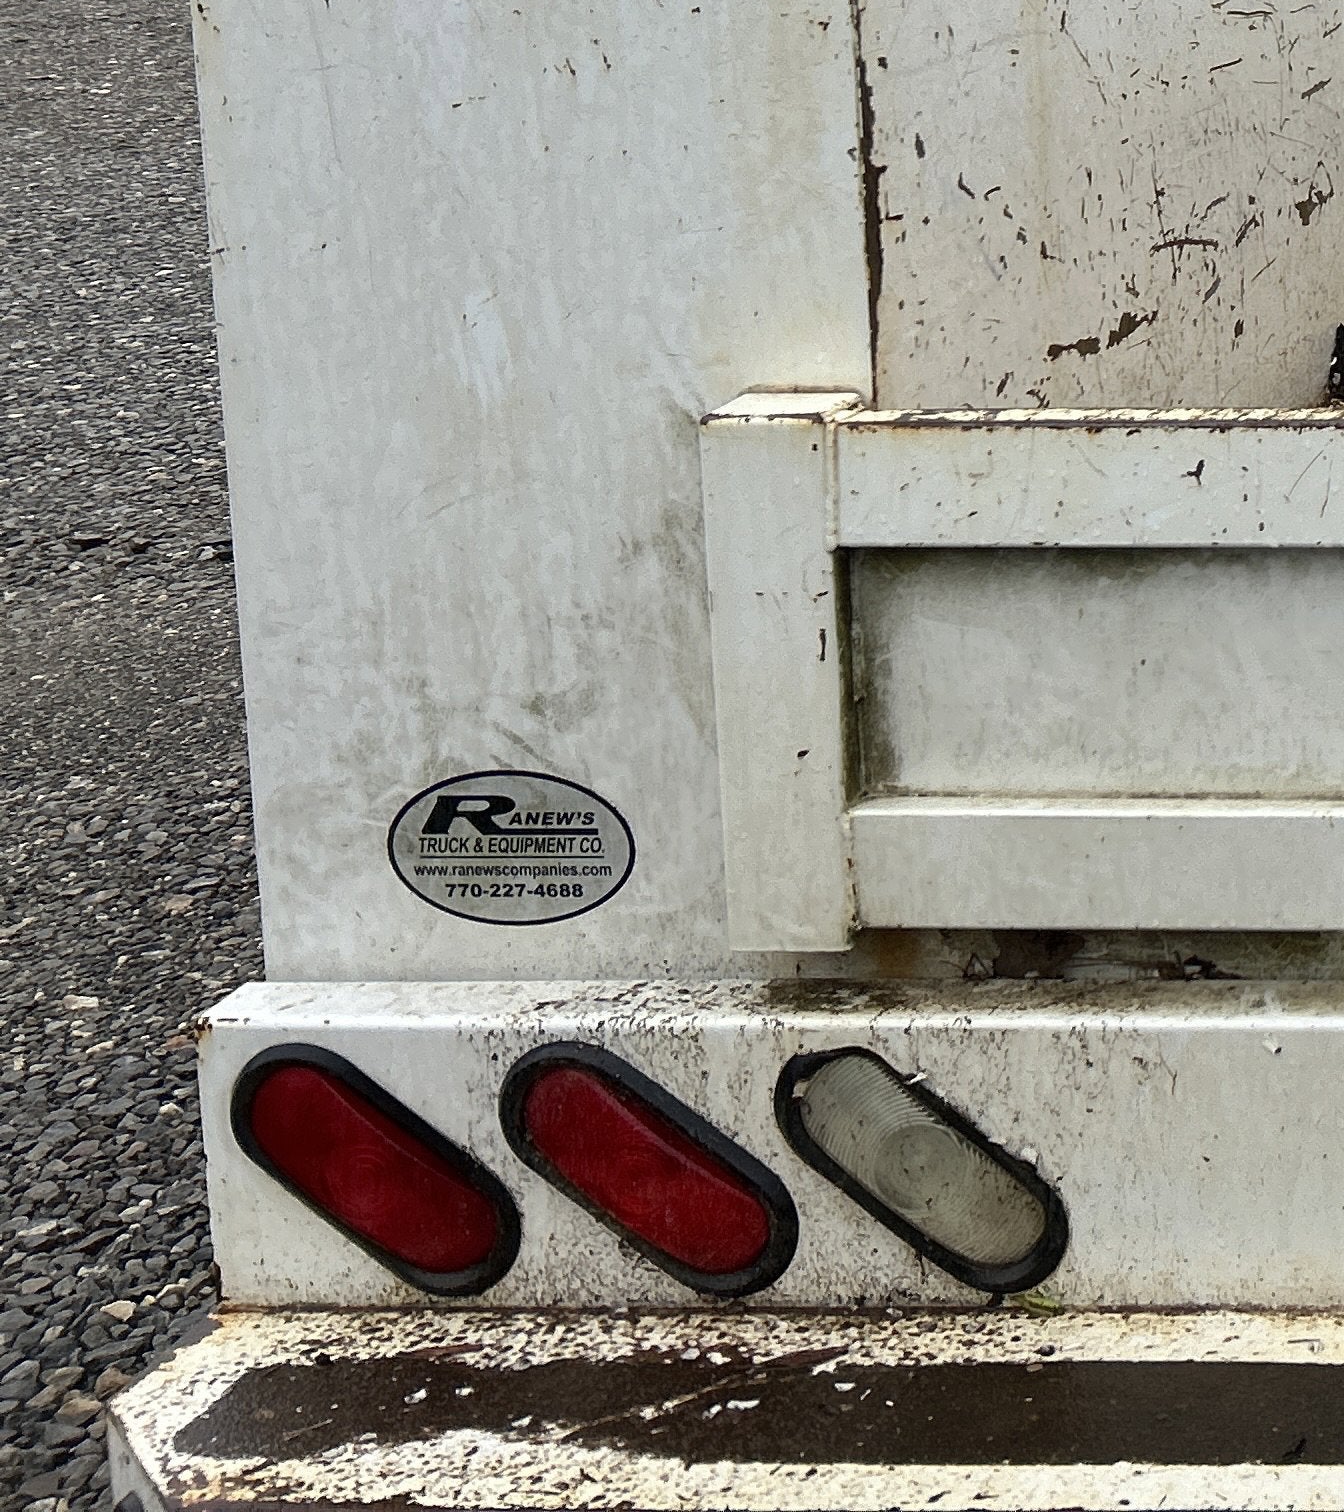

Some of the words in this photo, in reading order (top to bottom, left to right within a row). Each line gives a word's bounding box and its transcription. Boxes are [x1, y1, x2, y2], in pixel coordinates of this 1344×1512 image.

[421, 795, 596, 836] RANEW'S
[418, 837, 469, 854] TRUCK
[473, 838, 484, 854] &
[488, 837, 575, 855] EQUIPMENT
[579, 838, 606, 854] CO.
[413, 861, 613, 879] www.ranewscompanies.com
[445, 883, 584, 898] 770-227-4688
